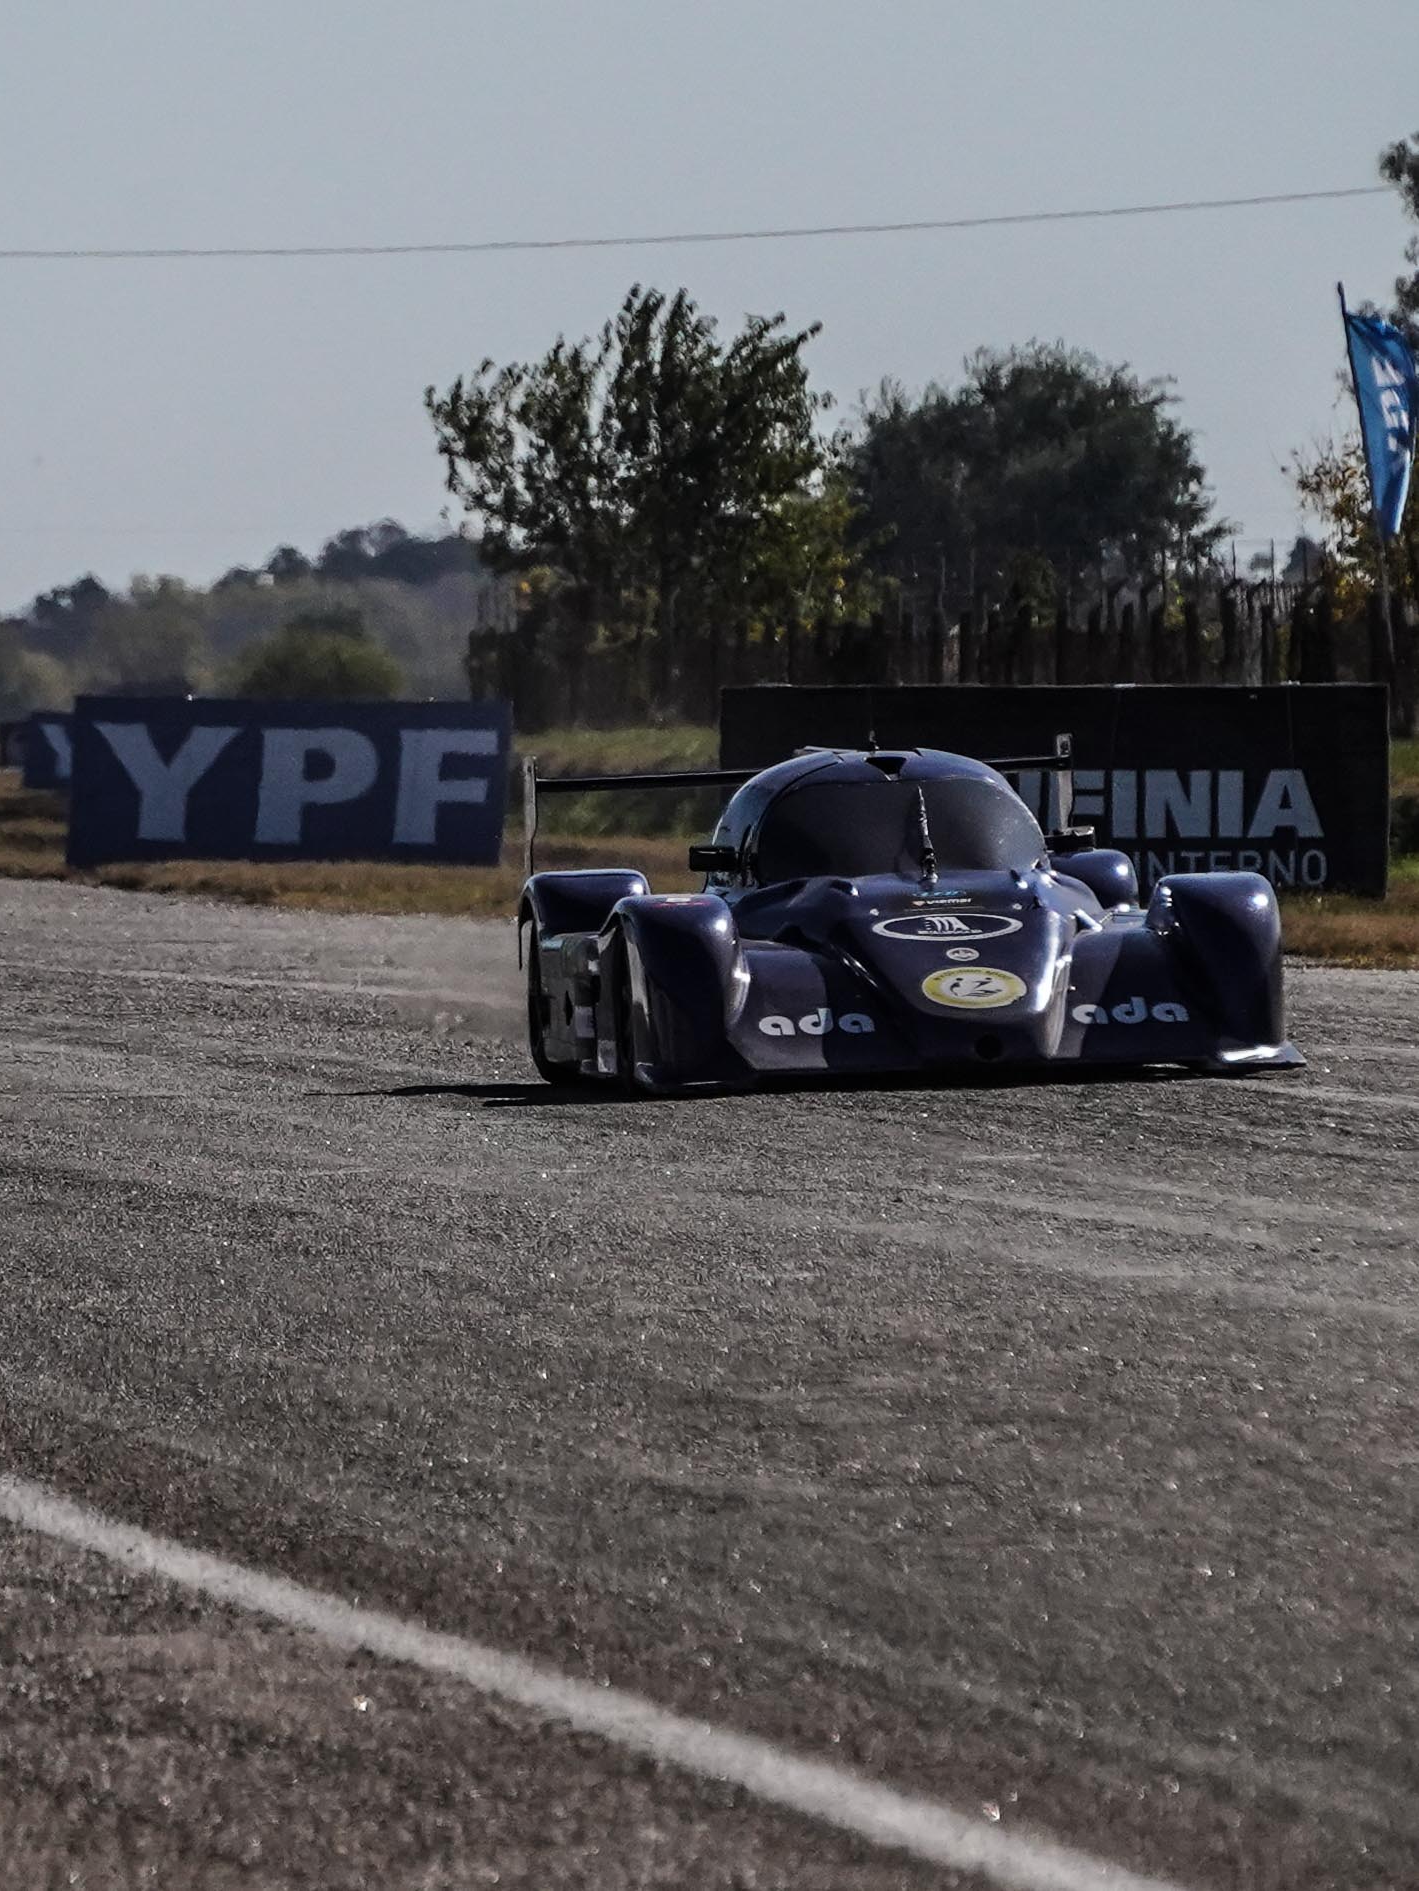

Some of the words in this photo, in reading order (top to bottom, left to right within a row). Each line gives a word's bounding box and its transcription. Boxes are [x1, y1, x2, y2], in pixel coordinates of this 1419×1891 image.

[91, 722, 500, 844] YPF
[758, 1007, 877, 1037] ada
[1071, 996, 1191, 1025] ada
